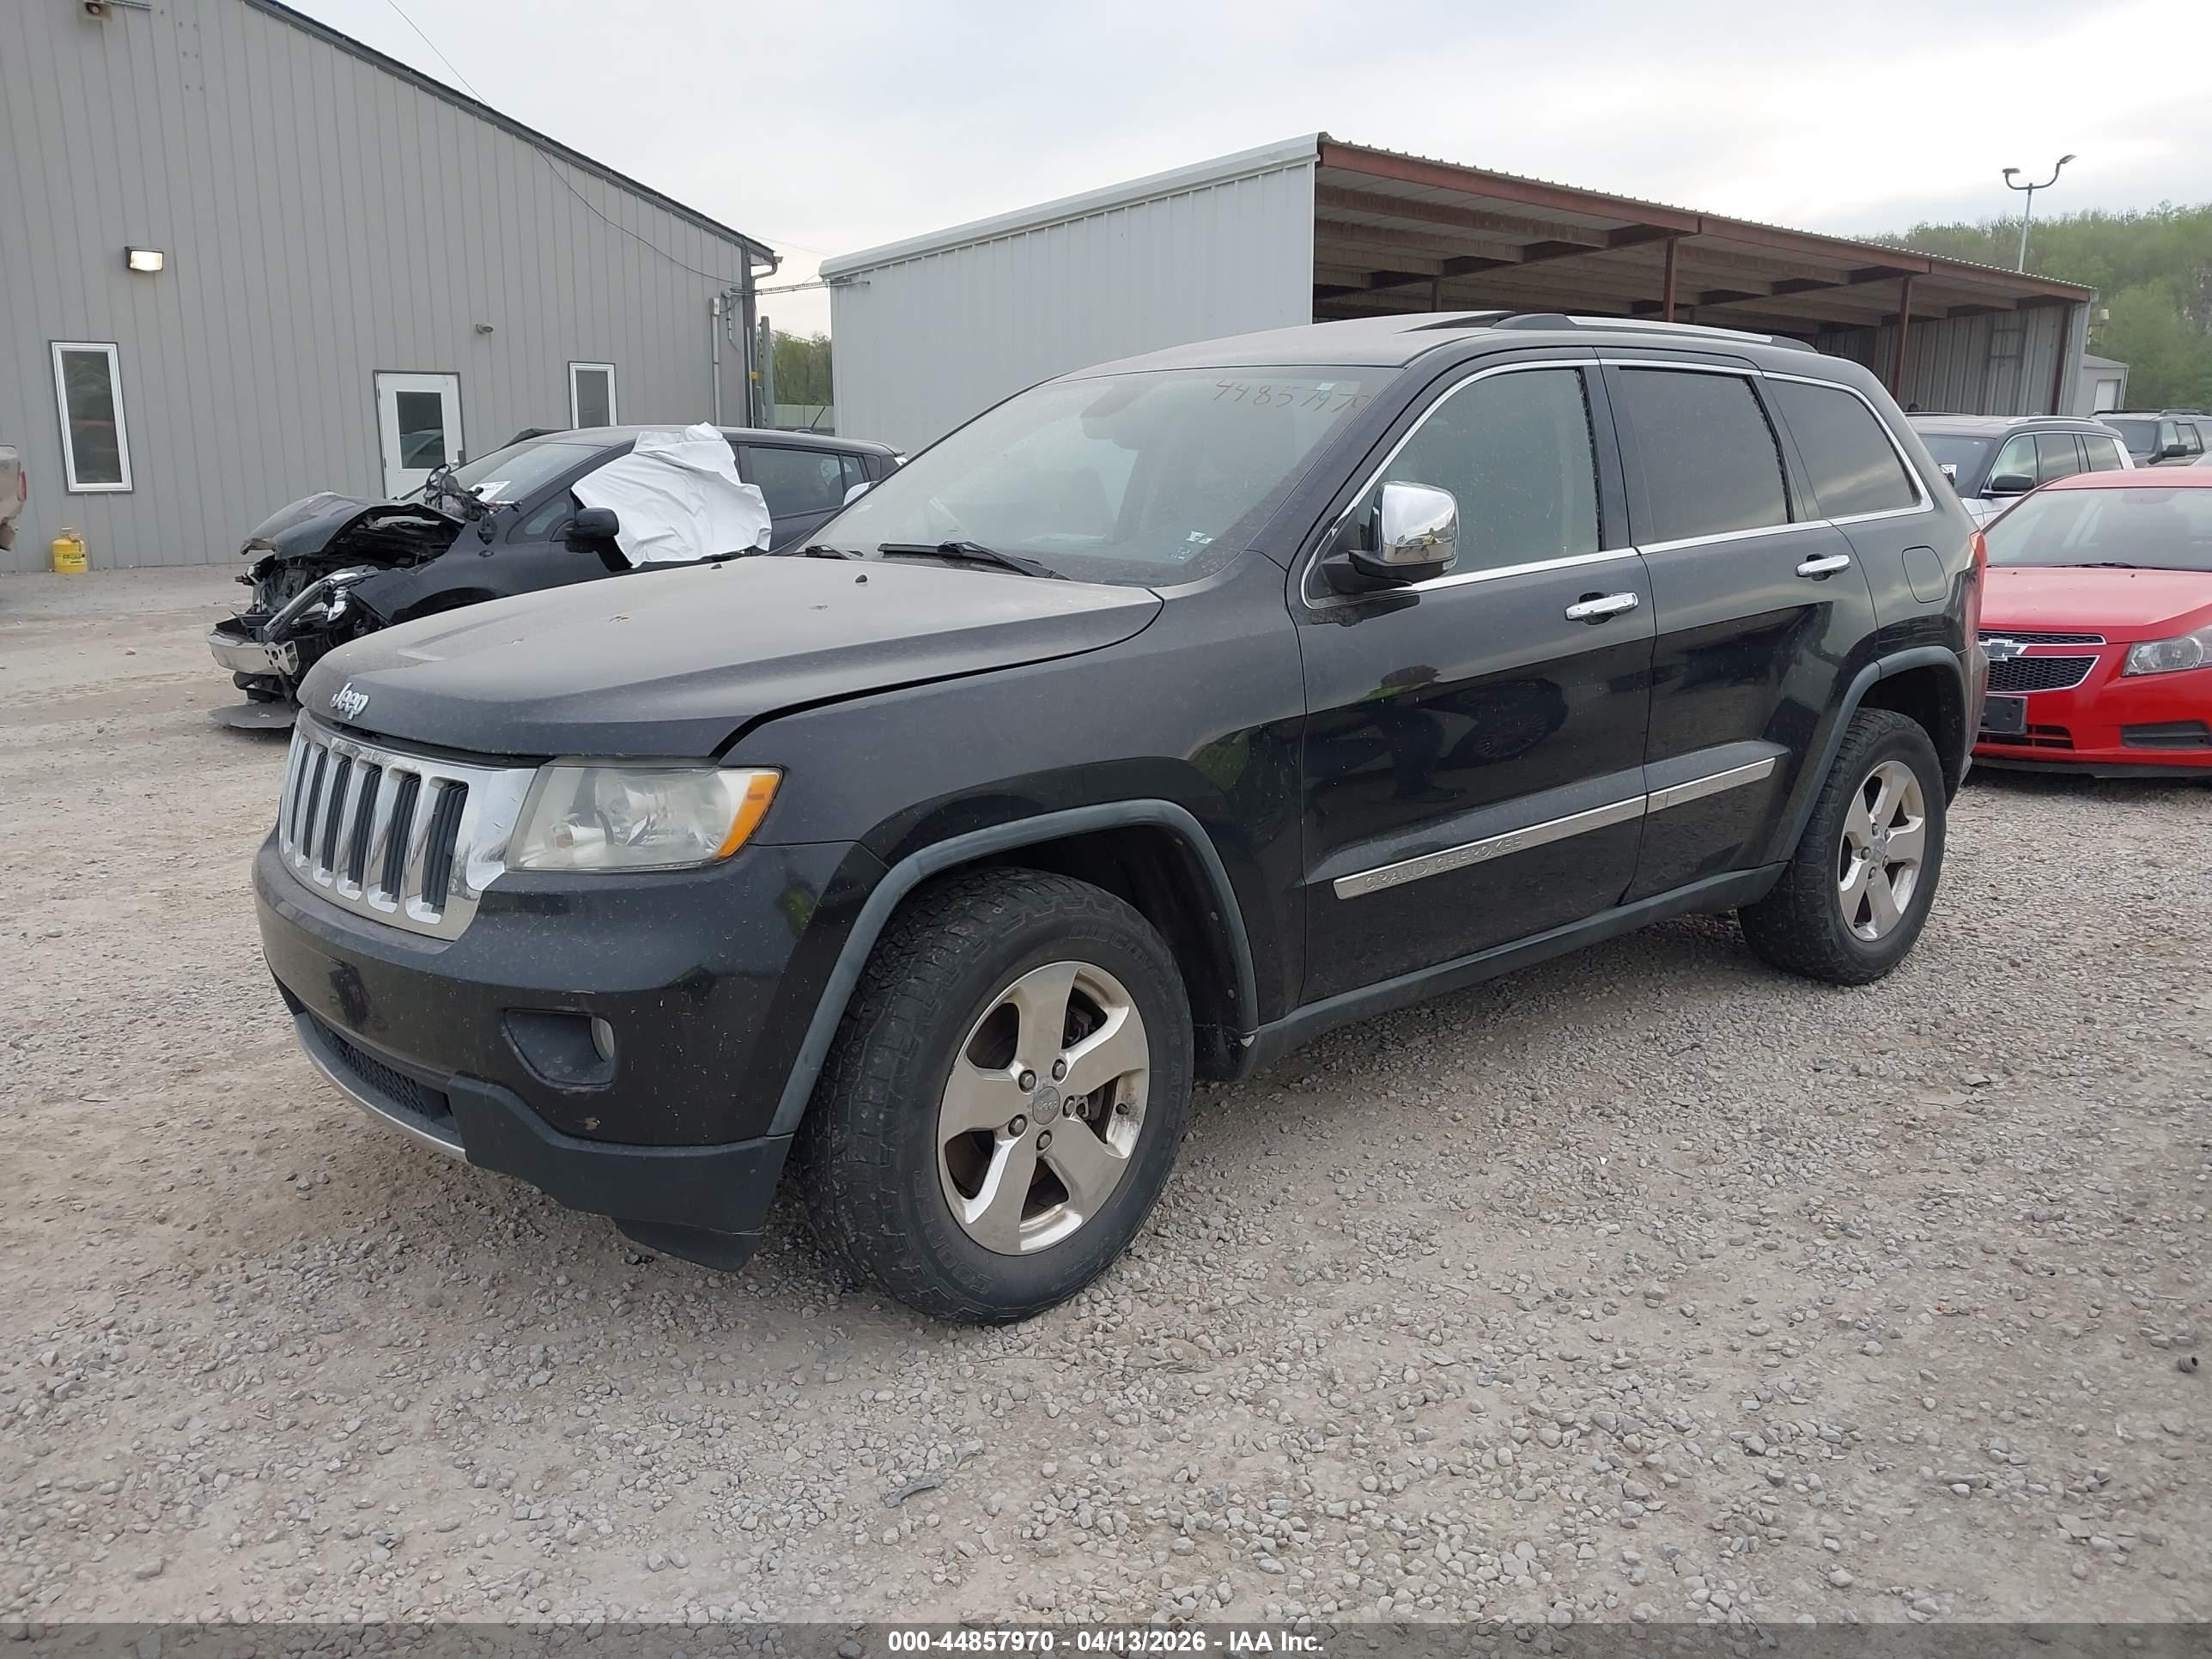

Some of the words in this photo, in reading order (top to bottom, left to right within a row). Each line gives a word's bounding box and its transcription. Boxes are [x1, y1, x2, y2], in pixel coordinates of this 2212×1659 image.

[330, 682, 369, 720] Jeep
[1365, 861, 1429, 890] GRAND
[1436, 836, 1522, 872] CHEROKEE
